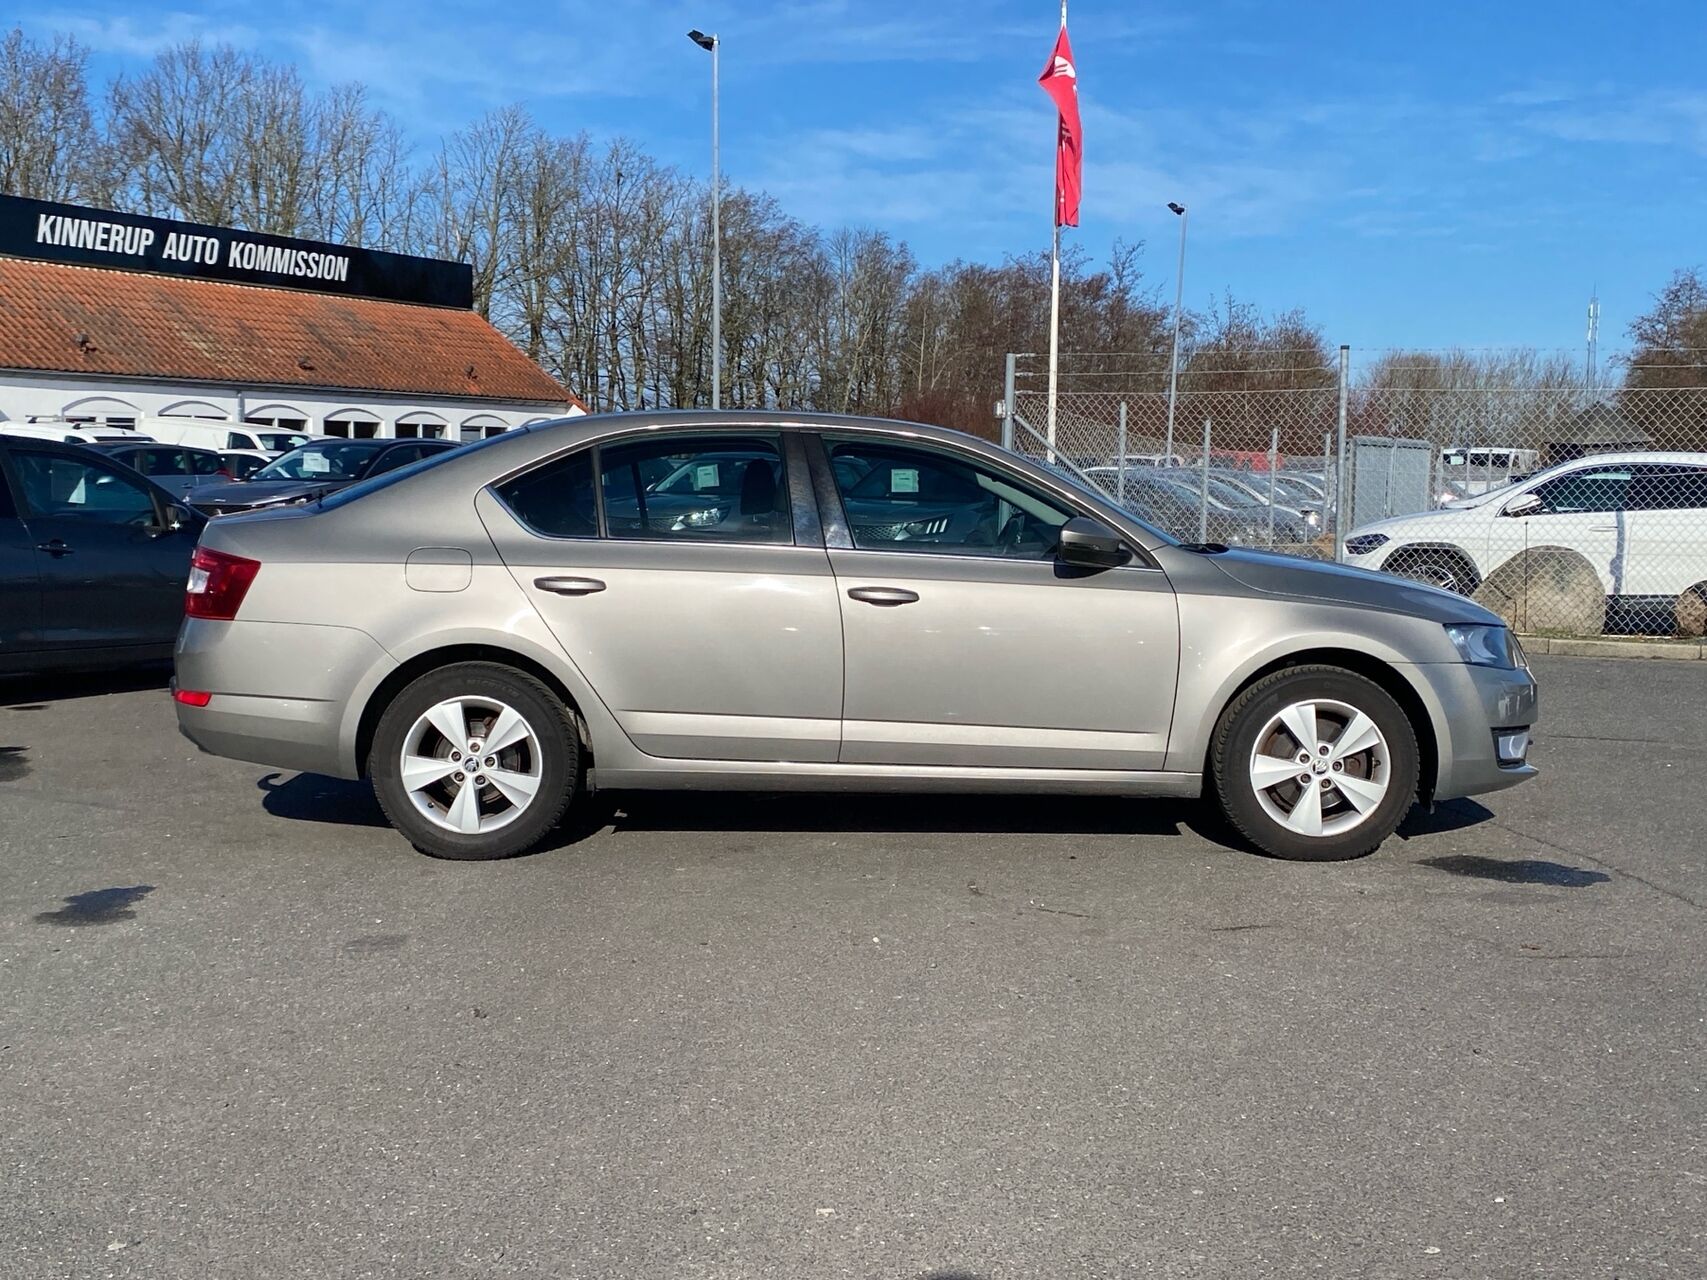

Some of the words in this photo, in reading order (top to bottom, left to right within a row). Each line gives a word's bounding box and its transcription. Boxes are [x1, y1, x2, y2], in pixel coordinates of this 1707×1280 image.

[36, 213, 154, 256] KINNERUP
[162, 232, 219, 265] AUTO
[228, 242, 349, 282] KOMMISSION
